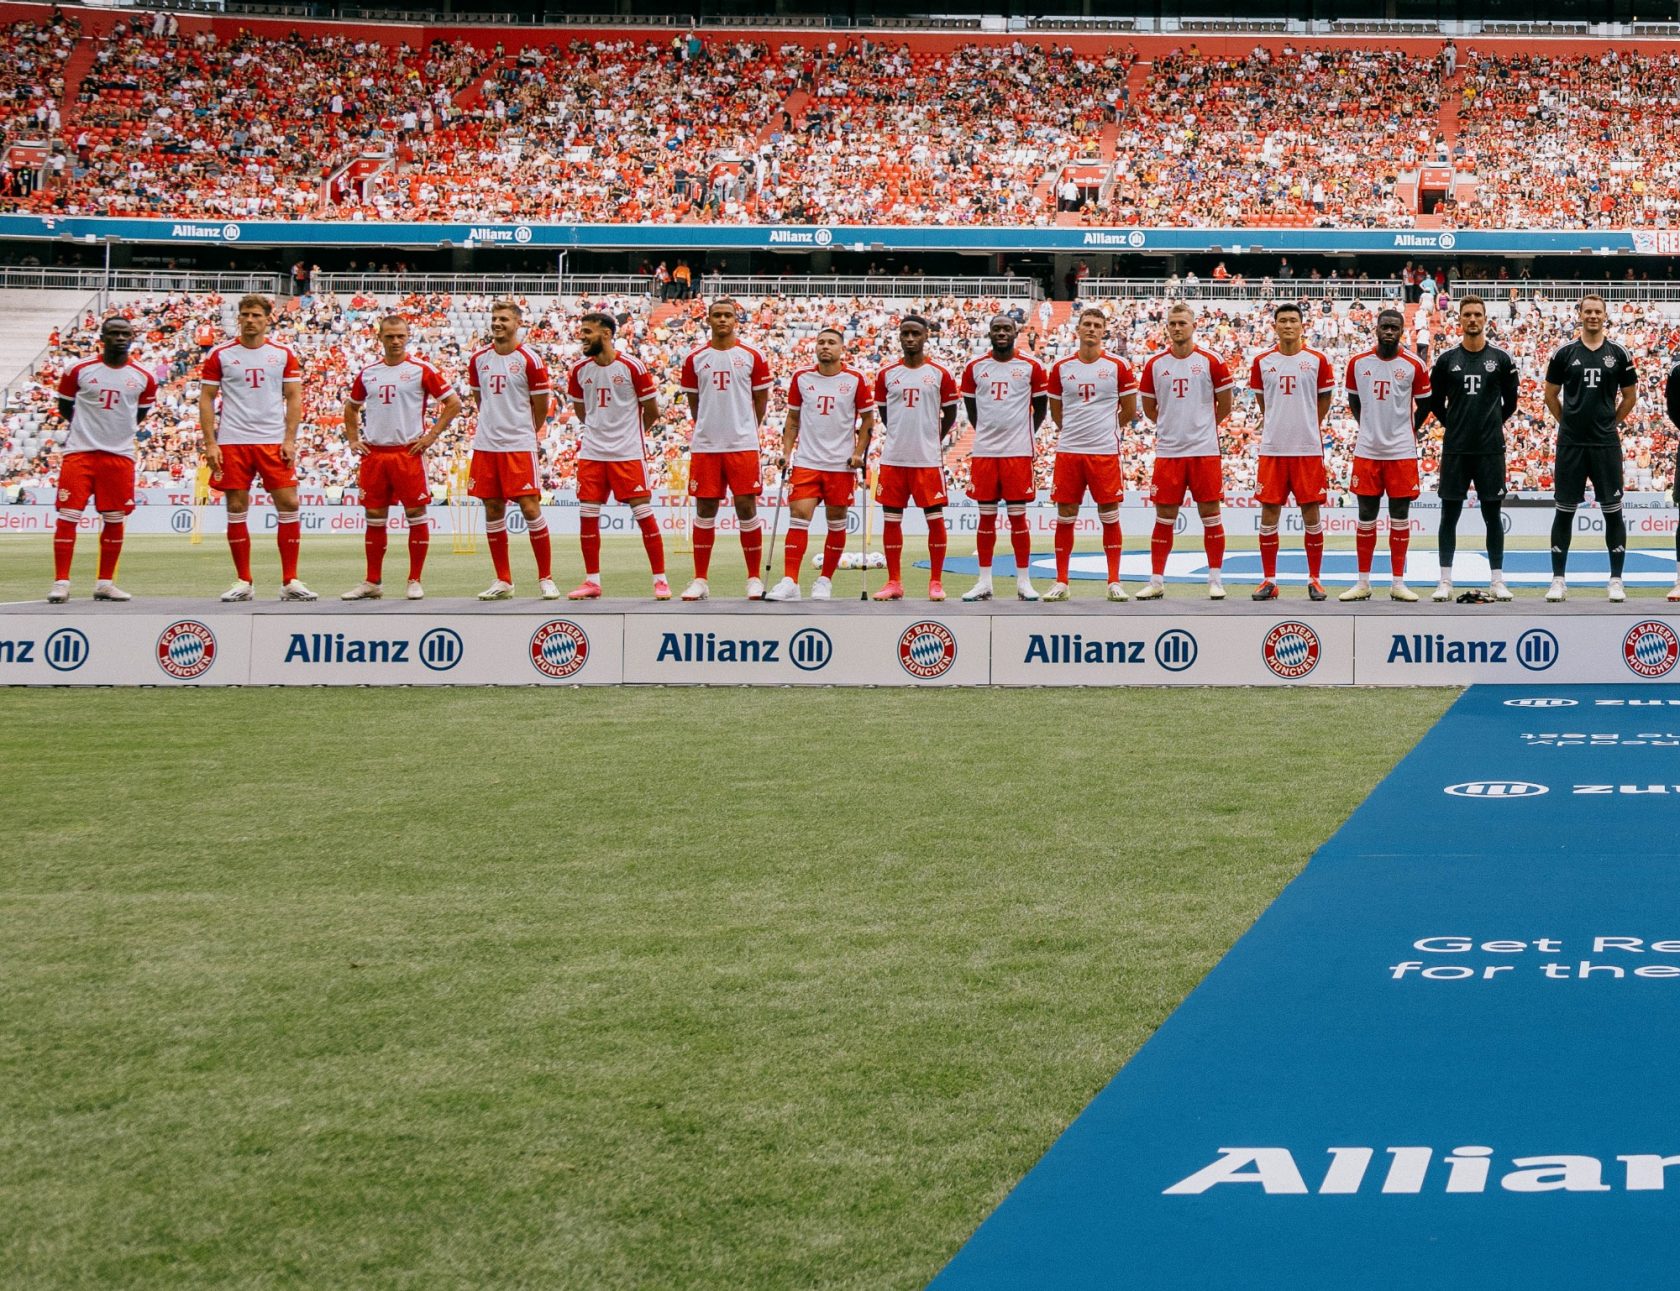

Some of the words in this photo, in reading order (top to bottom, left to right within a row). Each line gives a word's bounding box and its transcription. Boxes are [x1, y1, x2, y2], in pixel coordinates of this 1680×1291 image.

[172, 225, 220, 238] Allianz
[469, 228, 513, 240] Allianz
[769, 231, 813, 242] Allianz
[1083, 233, 1127, 244] Allianz
[1394, 235, 1436, 246] Allianz
[162, 630, 174, 646] FC
[174, 624, 211, 646] BAYERN
[535, 630, 546, 645] FC
[547, 624, 583, 645] BAYERN
[903, 631, 914, 646] FC
[915, 625, 951, 646] BAYERN
[1268, 631, 1279, 646] FC
[1279, 625, 1315, 646] BAYERN
[1628, 630, 1638, 645] FC
[1639, 624, 1675, 645] BAYERN
[287, 634, 407, 663] Allianz
[658, 633, 777, 663] Allianz
[1026, 635, 1143, 663] Allianz
[1388, 635, 1506, 663] Allianz
[162, 655, 211, 676] MÜNCHEN
[534, 654, 583, 675] MÜNCHEN
[902, 655, 951, 676] MÜNCHEN
[1267, 655, 1315, 675] MÜNCHEN
[1627, 654, 1675, 674] MÜNCHEN
[1413, 936, 1562, 953] Get
[1389, 961, 1514, 979] for
